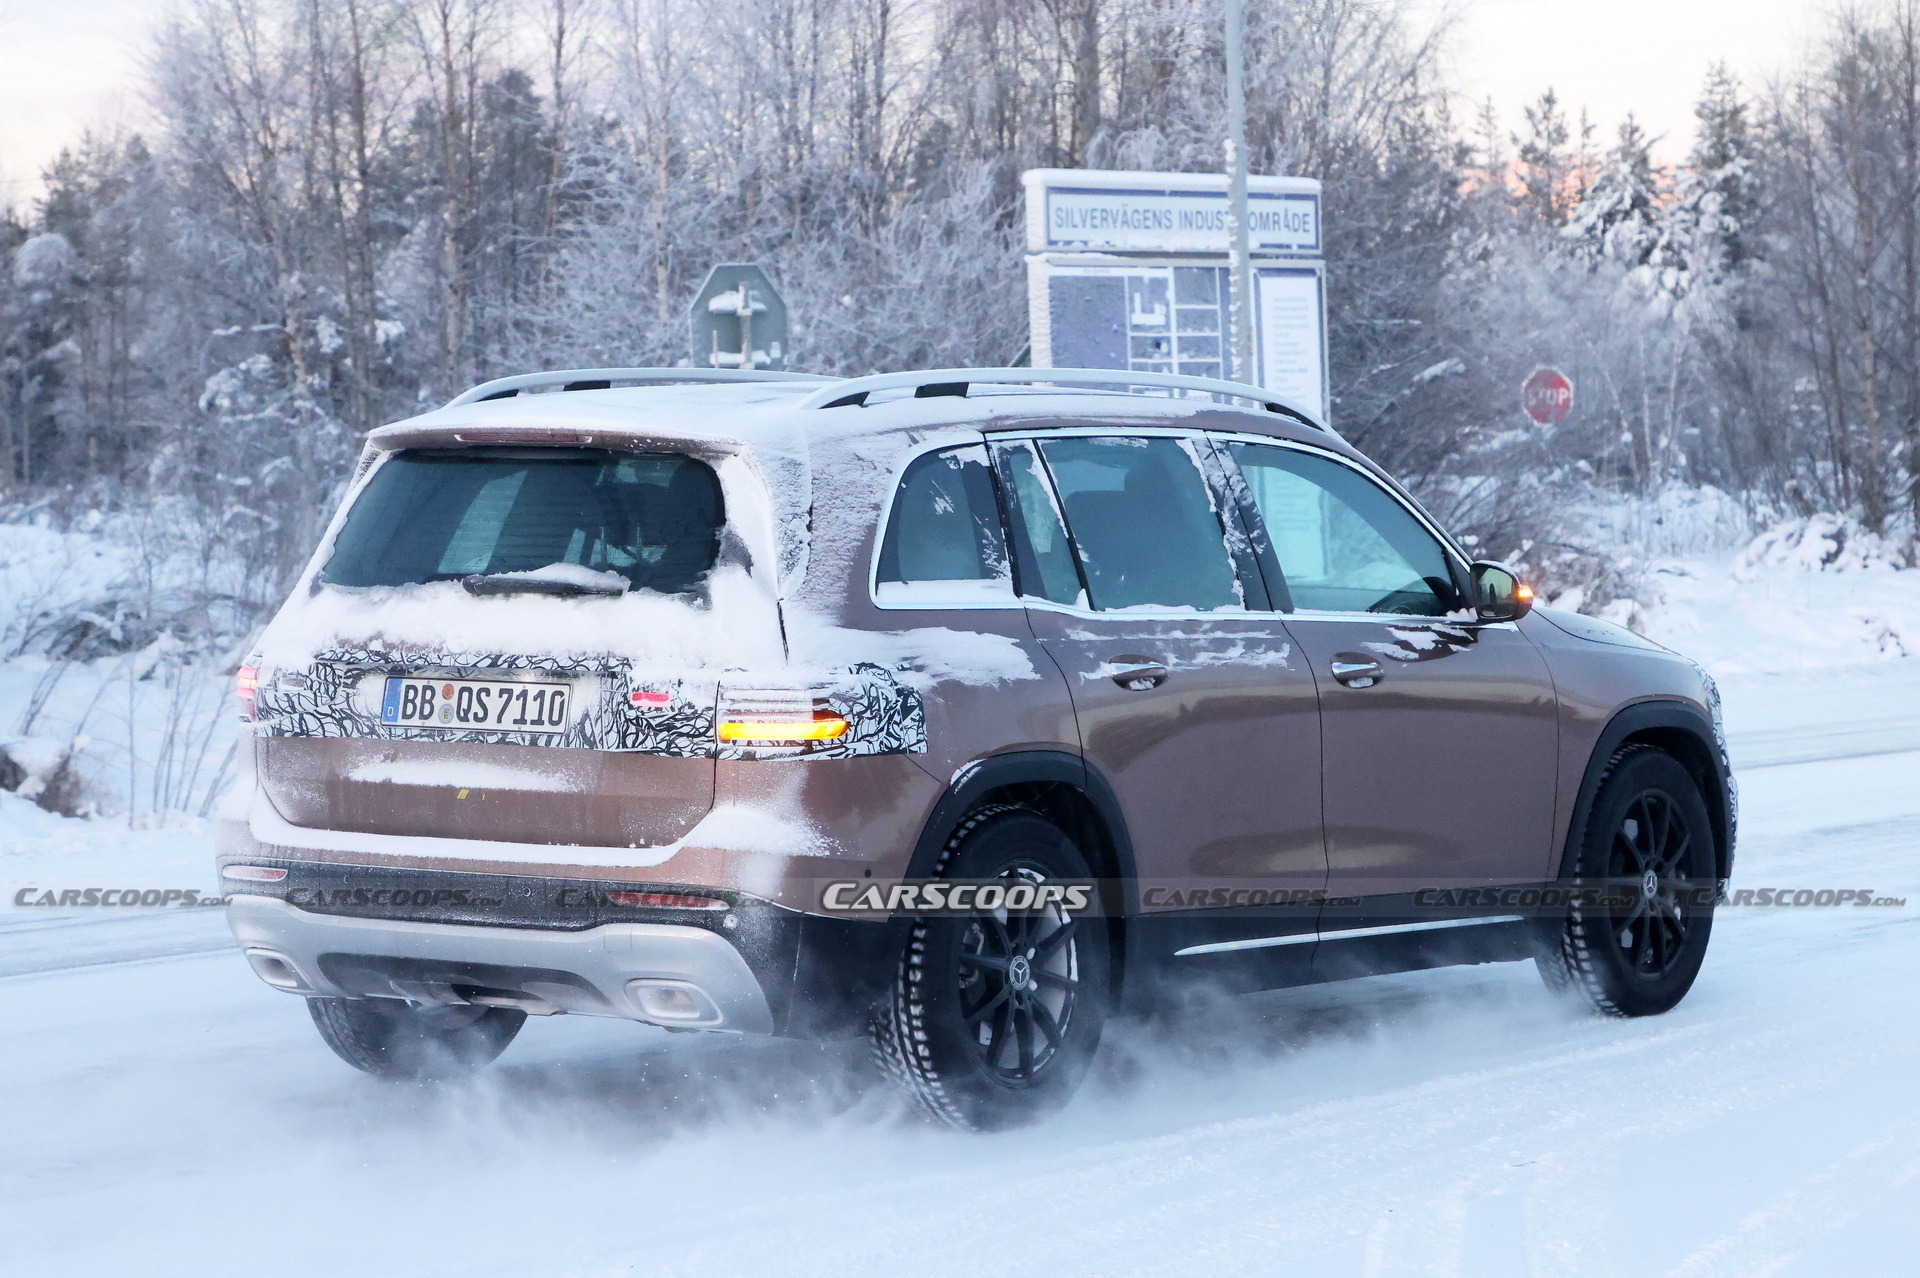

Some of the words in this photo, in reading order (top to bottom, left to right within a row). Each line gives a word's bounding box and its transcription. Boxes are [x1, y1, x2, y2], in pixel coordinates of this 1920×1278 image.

[1055, 203, 1173, 229] SILVERVÄGENS
[1528, 387, 1569, 405] STOP
[388, 706, 394, 717] D
[402, 684, 436, 720] BB
[456, 686, 491, 723] QS
[497, 688, 566, 726] 7110
